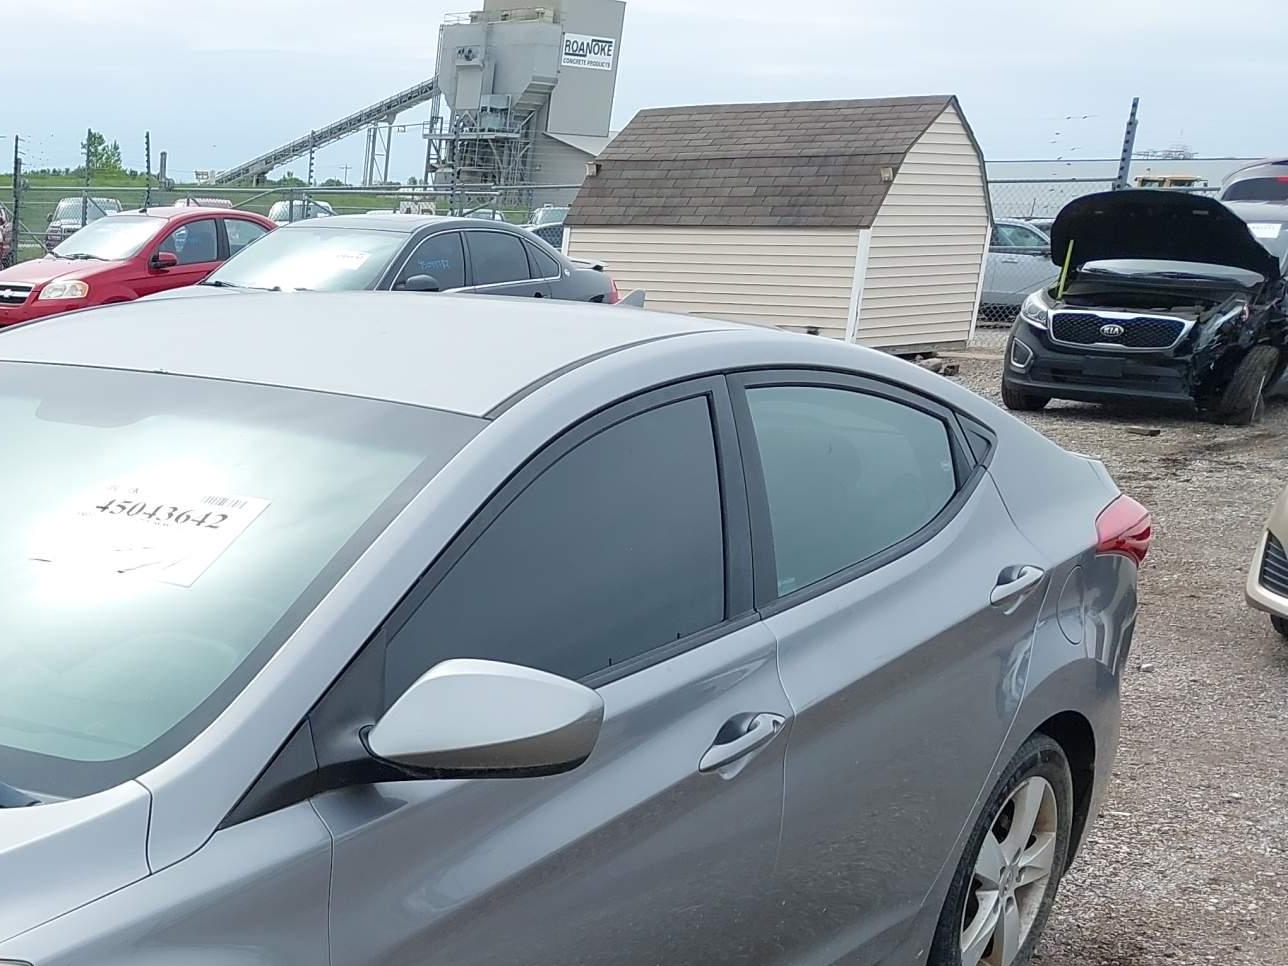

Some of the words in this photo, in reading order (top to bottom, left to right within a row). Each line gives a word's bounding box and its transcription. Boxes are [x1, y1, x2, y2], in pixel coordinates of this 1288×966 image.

[564, 40, 613, 57] ROANOKE
[562, 57, 586, 66] CONCRETE
[96, 499, 229, 529] 45043642
